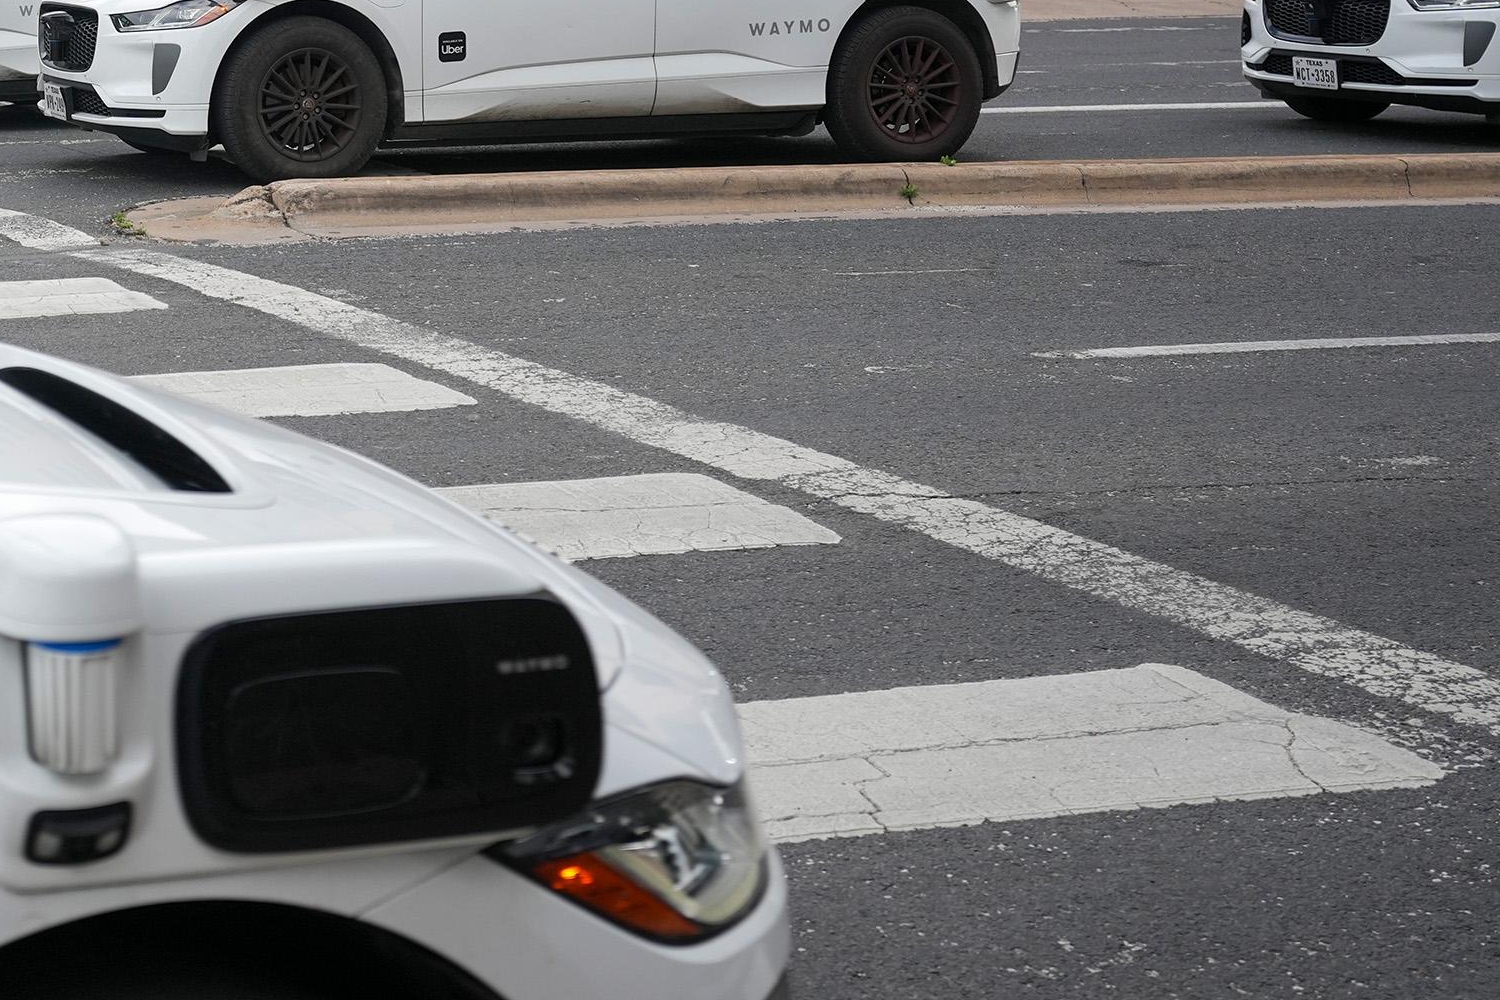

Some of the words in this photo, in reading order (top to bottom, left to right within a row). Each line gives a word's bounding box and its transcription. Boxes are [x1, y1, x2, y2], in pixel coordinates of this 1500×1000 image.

[749, 18, 830, 36] WAYMO
[441, 44, 464, 54] Uber
[1306, 59, 1323, 67] TEXAS
